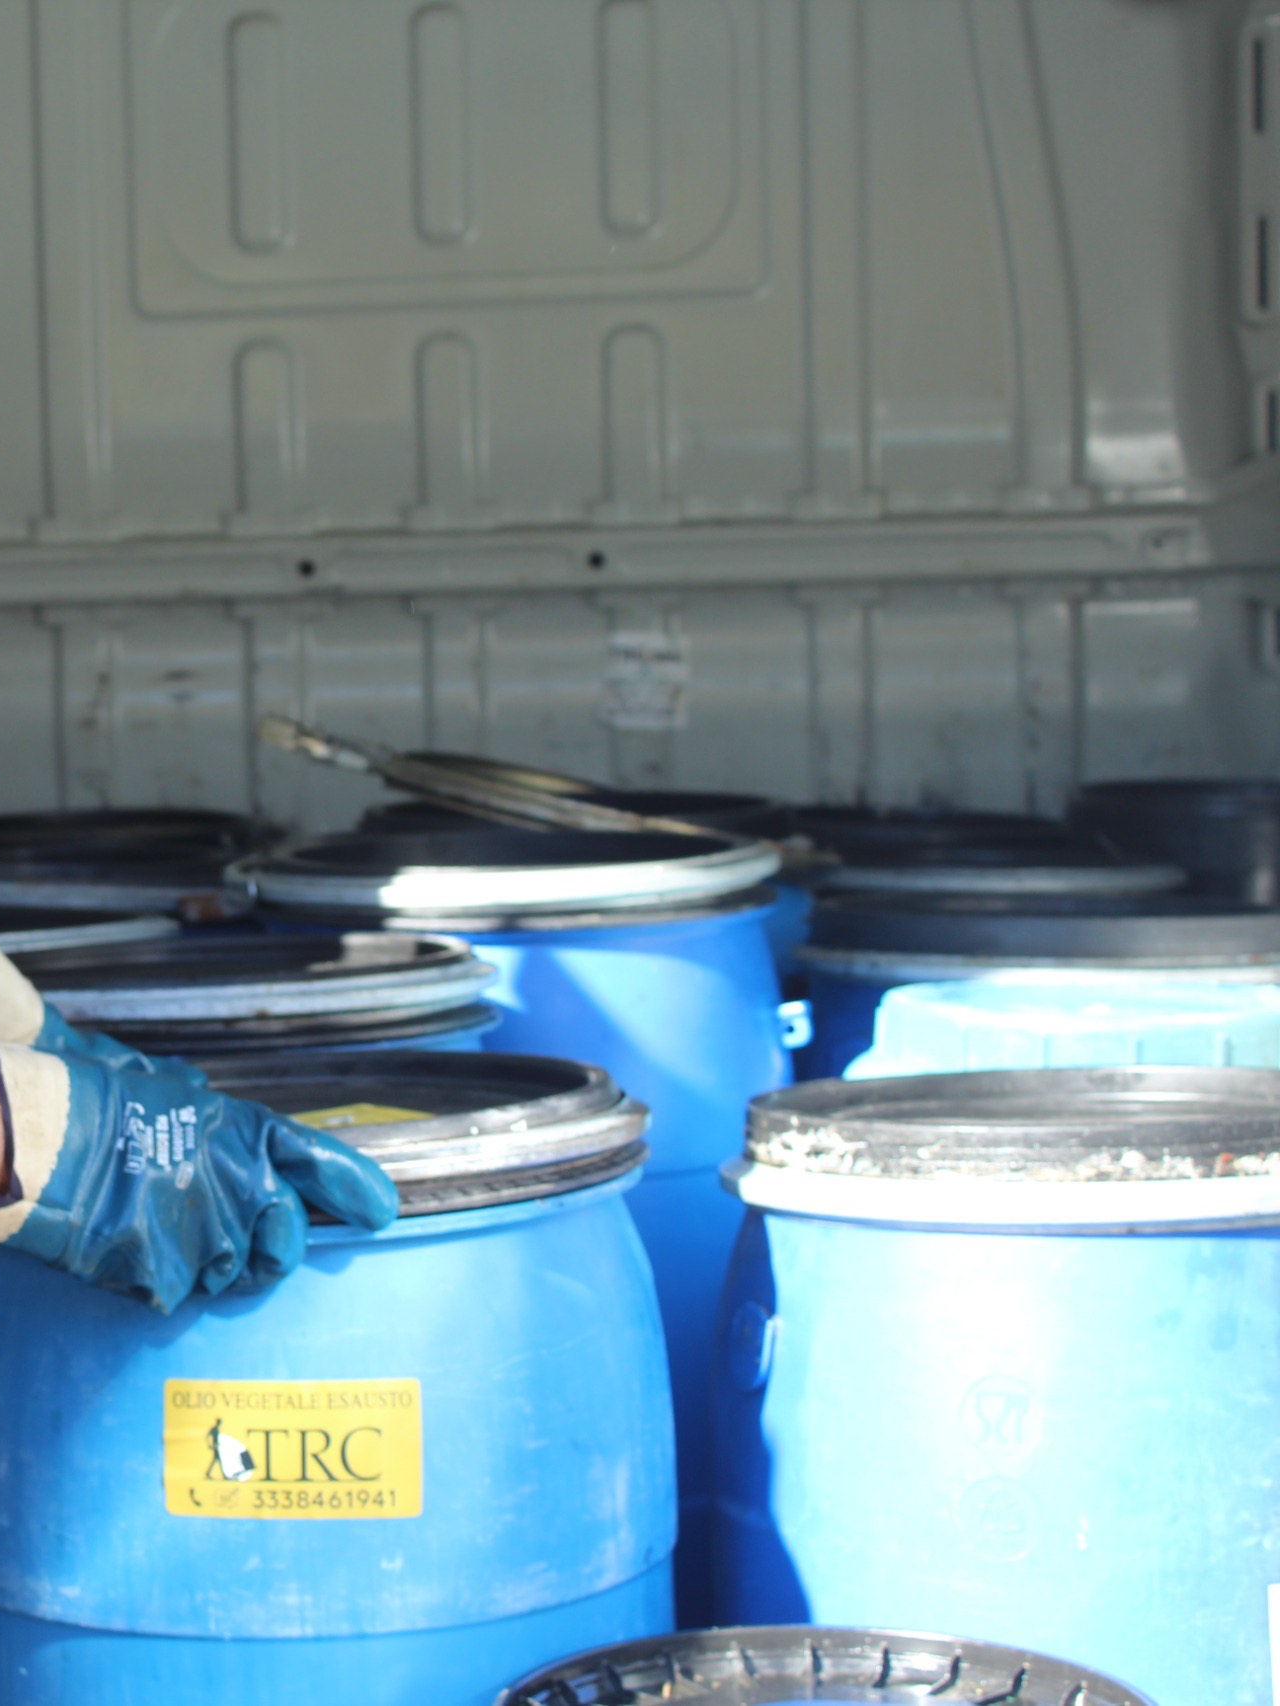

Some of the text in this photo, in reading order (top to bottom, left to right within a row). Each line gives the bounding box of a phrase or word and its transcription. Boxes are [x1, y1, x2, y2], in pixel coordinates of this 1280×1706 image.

[173, 1391, 412, 1410] OLIO VEGETALE ESAUSTO
[253, 1490, 397, 1509] 3338461941
